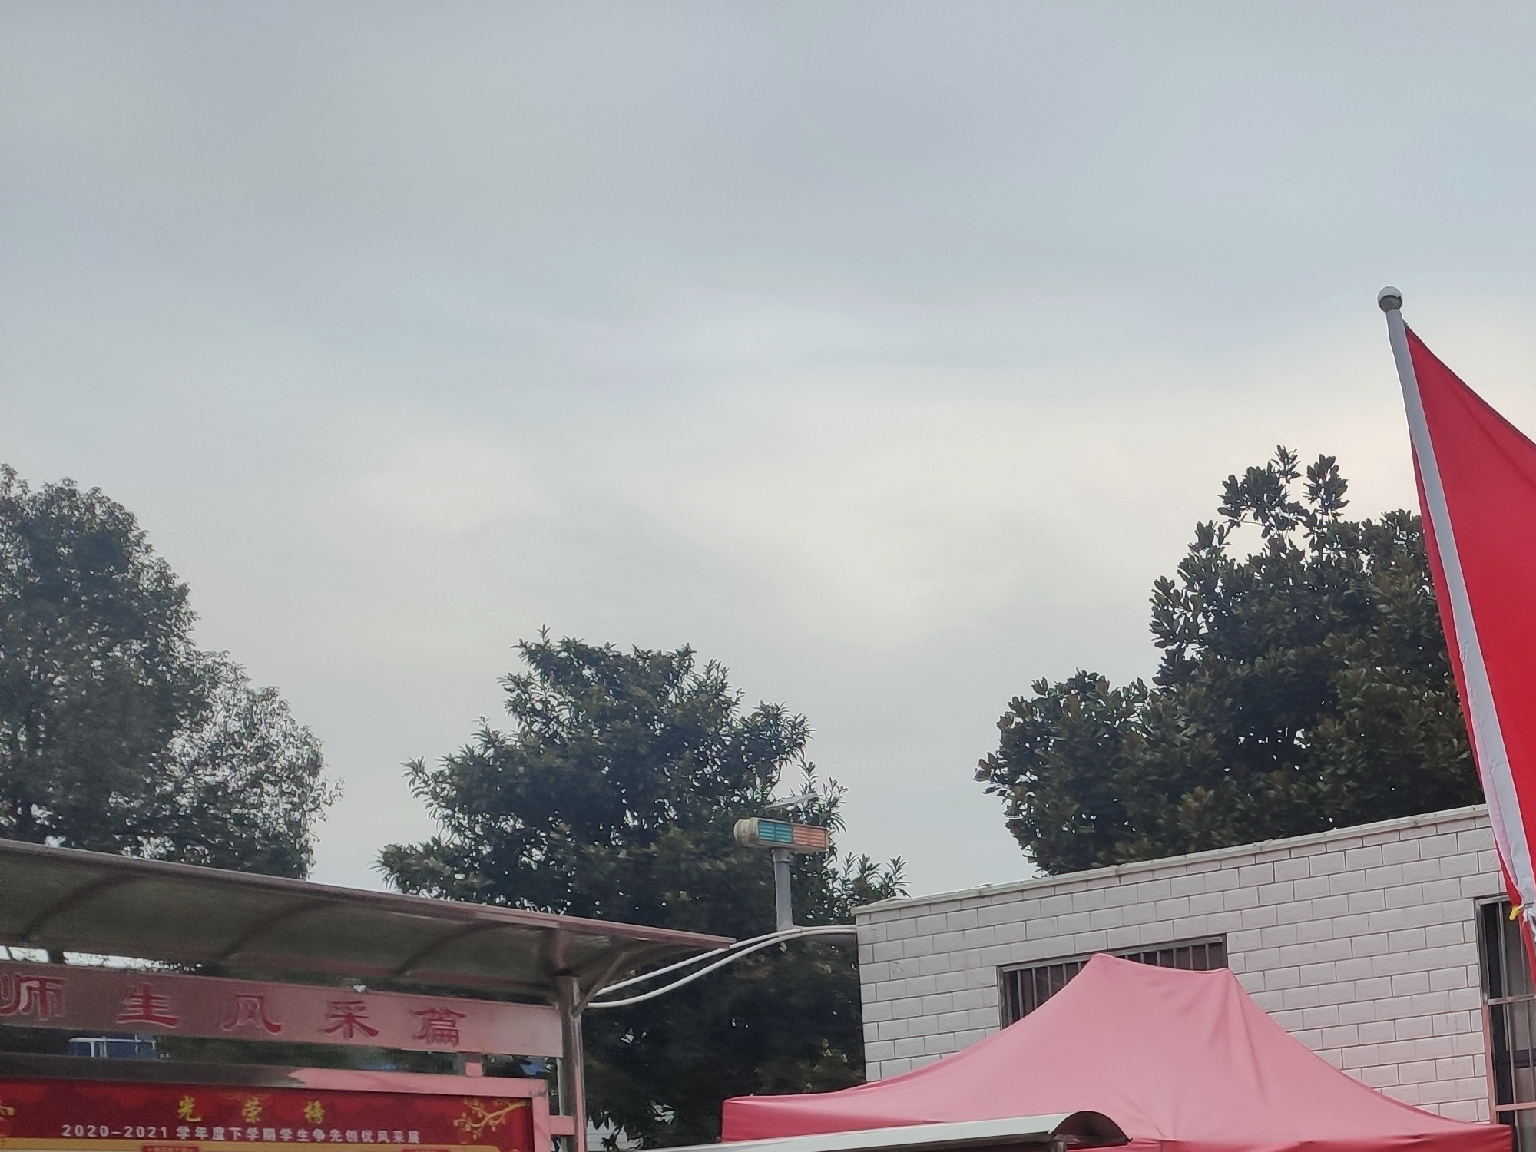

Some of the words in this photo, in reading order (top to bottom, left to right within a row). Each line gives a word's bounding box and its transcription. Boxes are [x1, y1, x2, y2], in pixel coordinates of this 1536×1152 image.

[0, 972, 467, 1047] 师生风采篇
